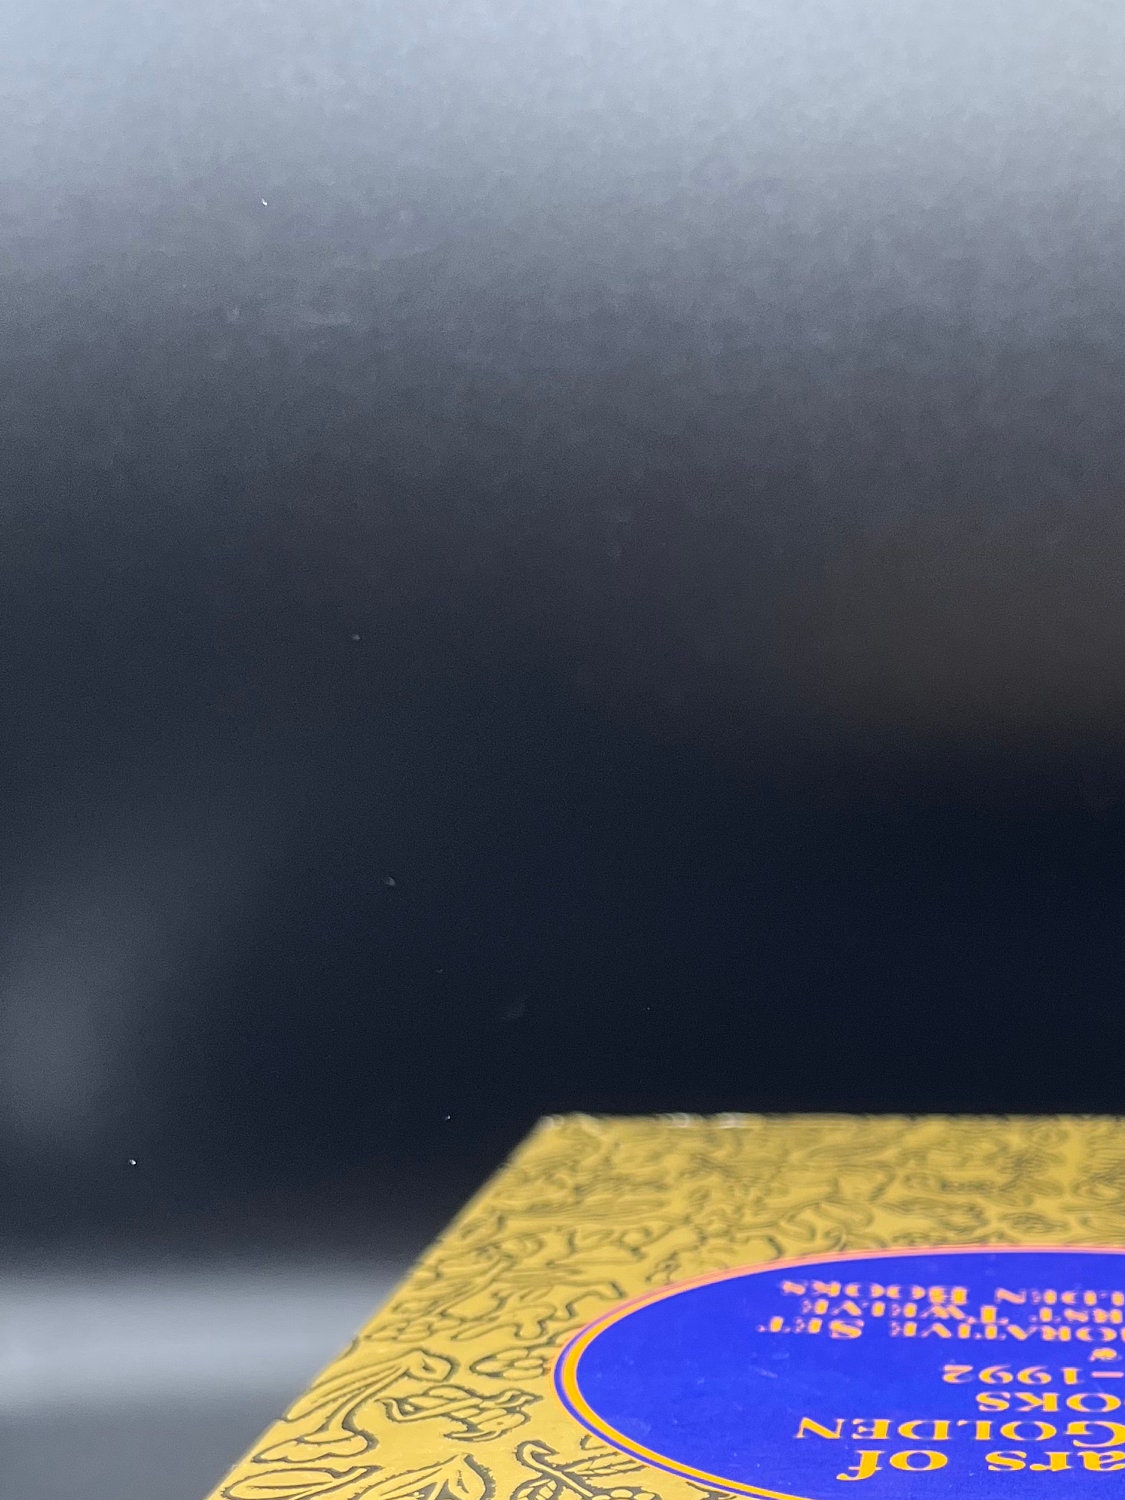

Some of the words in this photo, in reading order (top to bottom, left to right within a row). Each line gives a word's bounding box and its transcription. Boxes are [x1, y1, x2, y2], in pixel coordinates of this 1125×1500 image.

[781, 1279, 968, 1306] BOOKS
[801, 1298, 1010, 1325] TWELVE
[756, 1315, 866, 1340] SET
[836, 1449, 949, 1481] of
